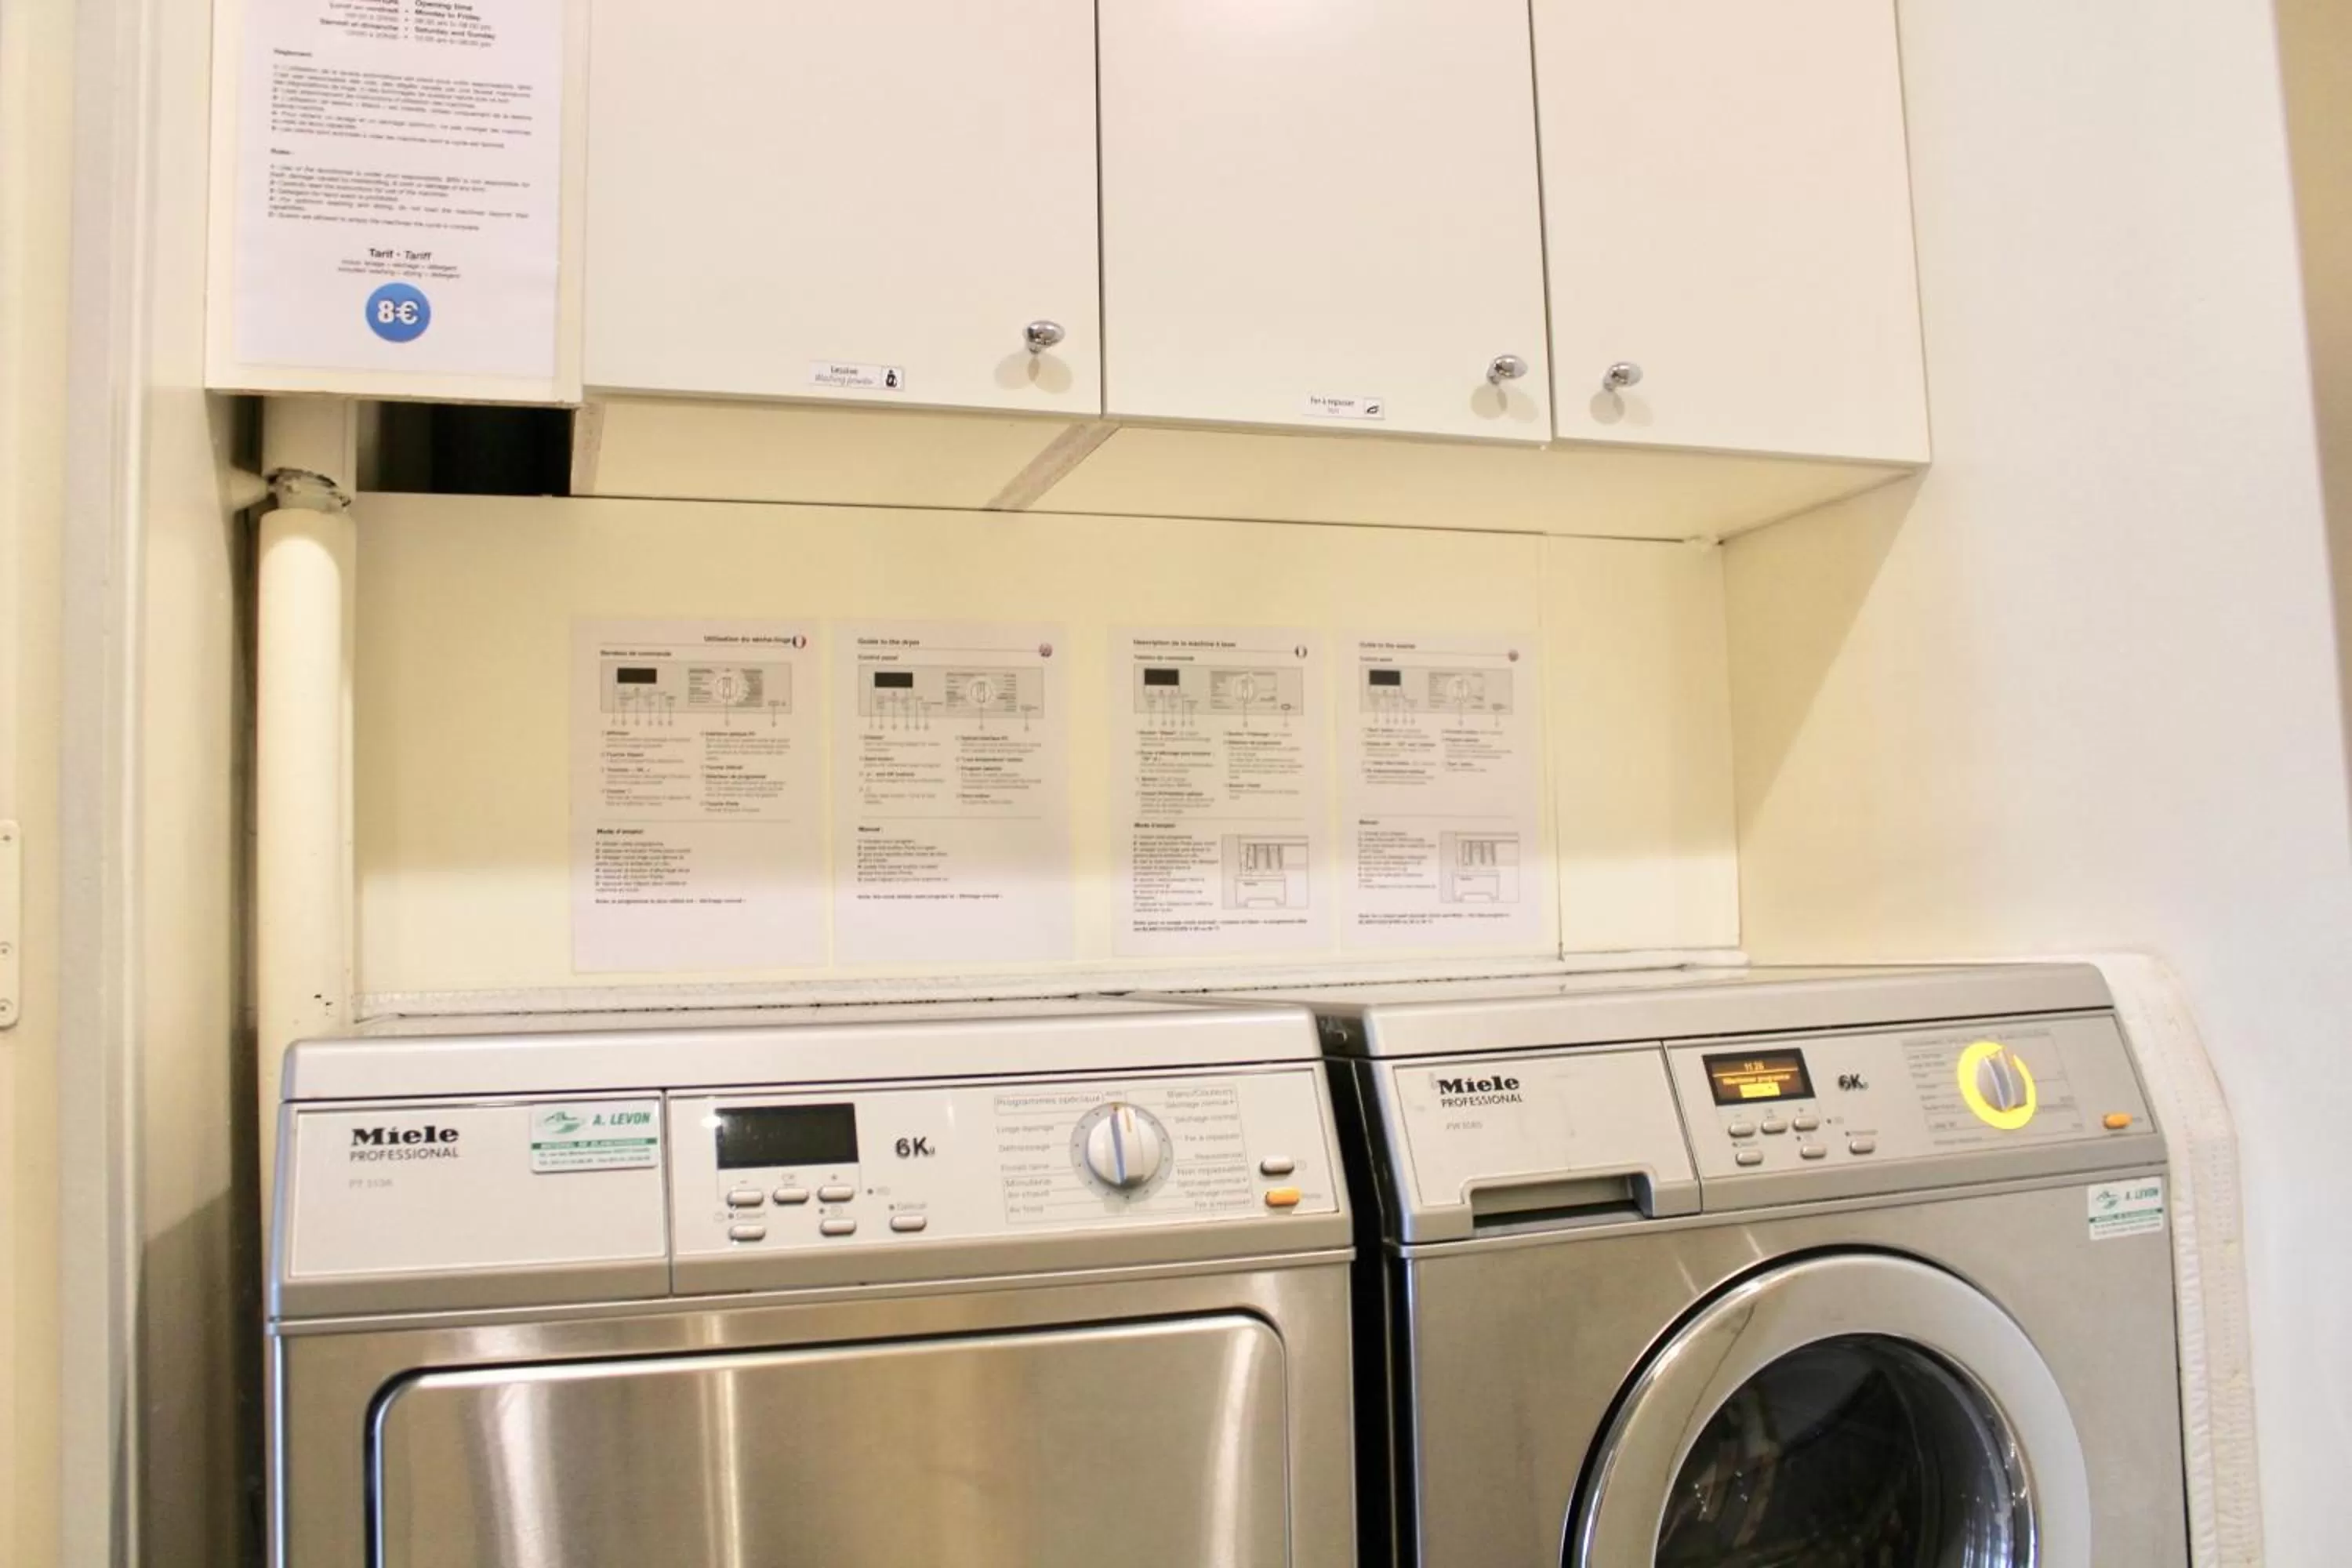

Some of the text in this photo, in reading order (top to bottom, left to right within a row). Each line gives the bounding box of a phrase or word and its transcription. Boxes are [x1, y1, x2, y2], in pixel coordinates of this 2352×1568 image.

[368, 248, 394, 259] Tarif
[405, 250, 433, 260] Tariff
[377, 299, 419, 325] 8€
[1438, 1076, 1519, 1095] Miele
[996, 1097, 1057, 1107] Programmes
[1441, 1094, 1523, 1109] PROFESSIONAL
[610, 1112, 651, 1126] LEVON
[351, 1124, 459, 1147] Miele
[350, 1147, 459, 1162] PROFESSIONAL
